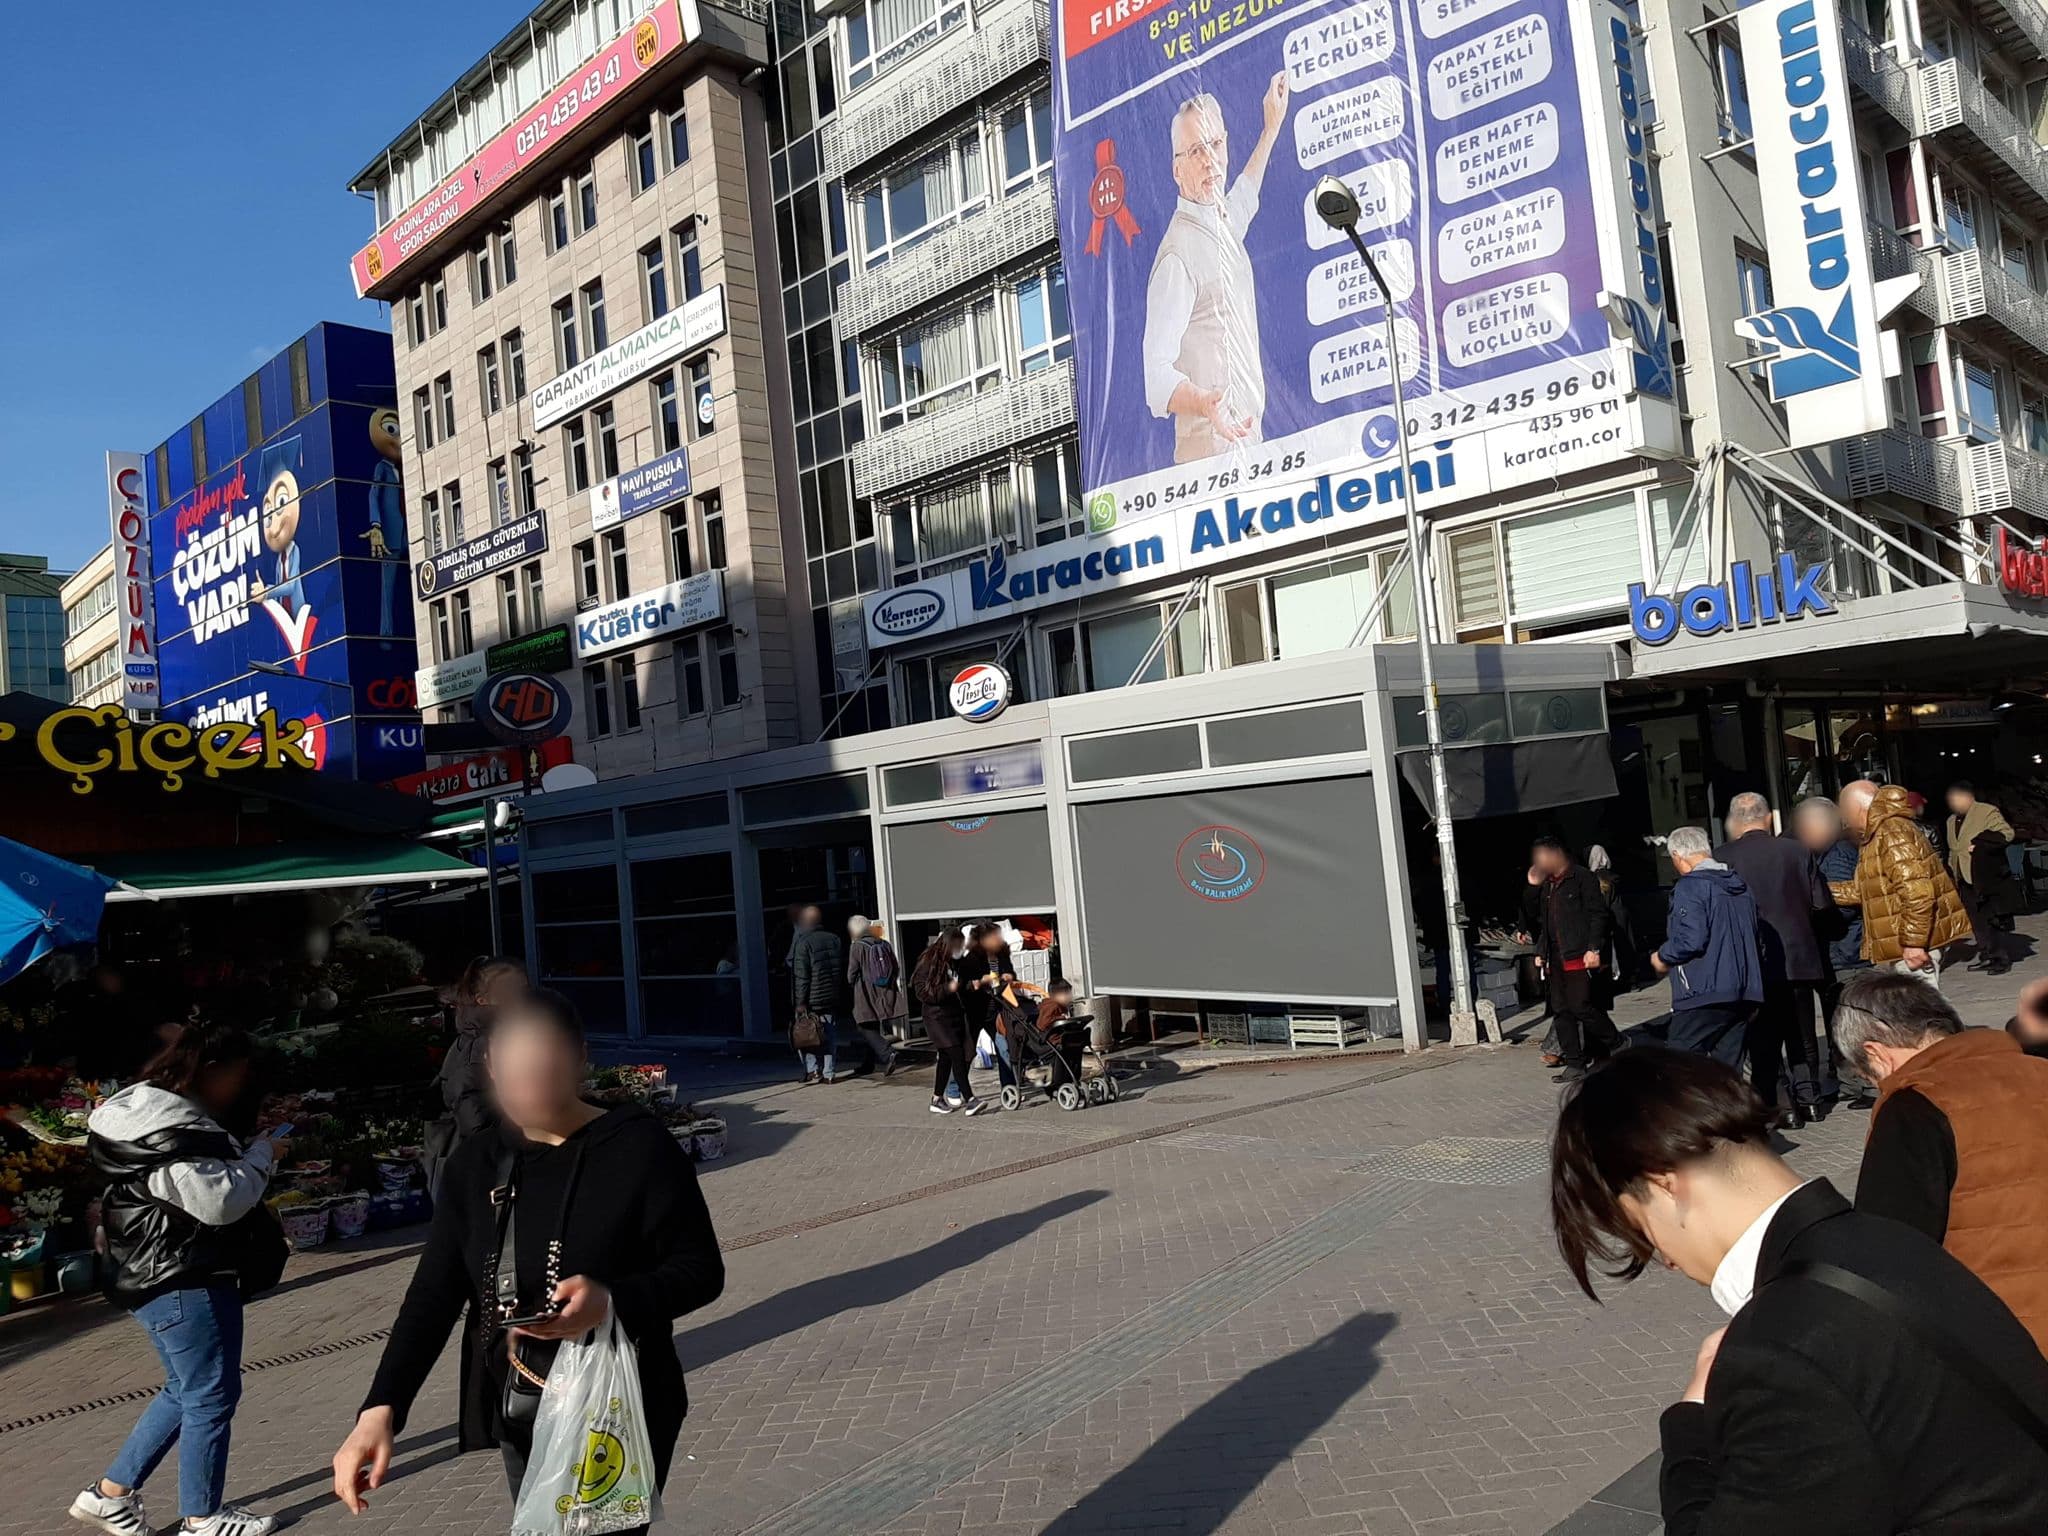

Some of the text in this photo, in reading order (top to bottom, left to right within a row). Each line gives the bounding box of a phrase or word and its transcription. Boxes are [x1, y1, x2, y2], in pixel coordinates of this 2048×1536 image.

[1090, 0, 1151, 35] FIRS
[1289, 6, 1388, 56] 41 YILLIK
[637, 38, 656, 62] GYM
[1164, 32, 1193, 59] VE
[1292, 30, 1388, 78] TECRÜBE
[1433, 19, 1542, 74] YAPAY ZEKA
[1447, 40, 1533, 89] DESTEKLİ
[516, 54, 620, 156] 0312 433 43 41
[1460, 67, 1523, 104] EĞİTİM
[1311, 89, 1381, 123] ALANINDA
[1322, 108, 1371, 133] UZMAN
[1300, 115, 1400, 159] ÖĞRETMENLER
[1444, 109, 1547, 159] HER HAFTA
[1459, 134, 1535, 173] DENEME
[1466, 156, 1528, 189] SINAVI
[393, 178, 465, 243] KADINLARA ÖZEL
[1099, 192, 1117, 207] YIL
[1446, 195, 1555, 240] 7 GÜN AKTİF
[400, 201, 459, 257] SPOR SALONU
[1464, 219, 1542, 253] ÇALIŞMA
[1470, 238, 1537, 268] ORTAMI
[1338, 287, 1378, 310] DERS
[1456, 280, 1551, 317] BİREYSEL
[1467, 303, 1535, 334] EĞİTİM
[600, 314, 681, 373] ALMANCA
[1461, 320, 1552, 358] KOÇLUĞU
[564, 385, 599, 409] YABANCI
[618, 358, 646, 381] KURSU
[1320, 352, 1407, 386] KAMPLAI
[1406, 368, 1615, 436] 0 312 435 96 0
[1529, 413, 1563, 434] 435
[1570, 406, 1593, 423] 96
[621, 471, 644, 495] MAVİ
[645, 456, 683, 485] PUSULA
[633, 487, 652, 501] TRAVEL
[1122, 451, 1305, 512] +90 544 768 34 85
[175, 459, 249, 547] problem yok
[437, 546, 468, 571] DİRİLİŞ
[469, 540, 491, 558] ÖZEL
[493, 516, 540, 545] GÜVENLİK
[969, 438, 1456, 611] Karacan Akademi
[172, 505, 261, 607] ÇÖZÜM
[453, 538, 526, 582] EĞİTİM MERKEZİ
[187, 573, 249, 645] VAR!
[881, 602, 936, 623] Karacan
[1628, 550, 1836, 644] balık
[578, 599, 675, 650] Kuaför
[128, 681, 155, 694] VIP
[499, 681, 555, 722] HD
[36, 702, 317, 794] Çiçek
[380, 726, 424, 747] KU
[466, 755, 509, 788] Cafe
[1204, 888, 1227, 898] BALIK
